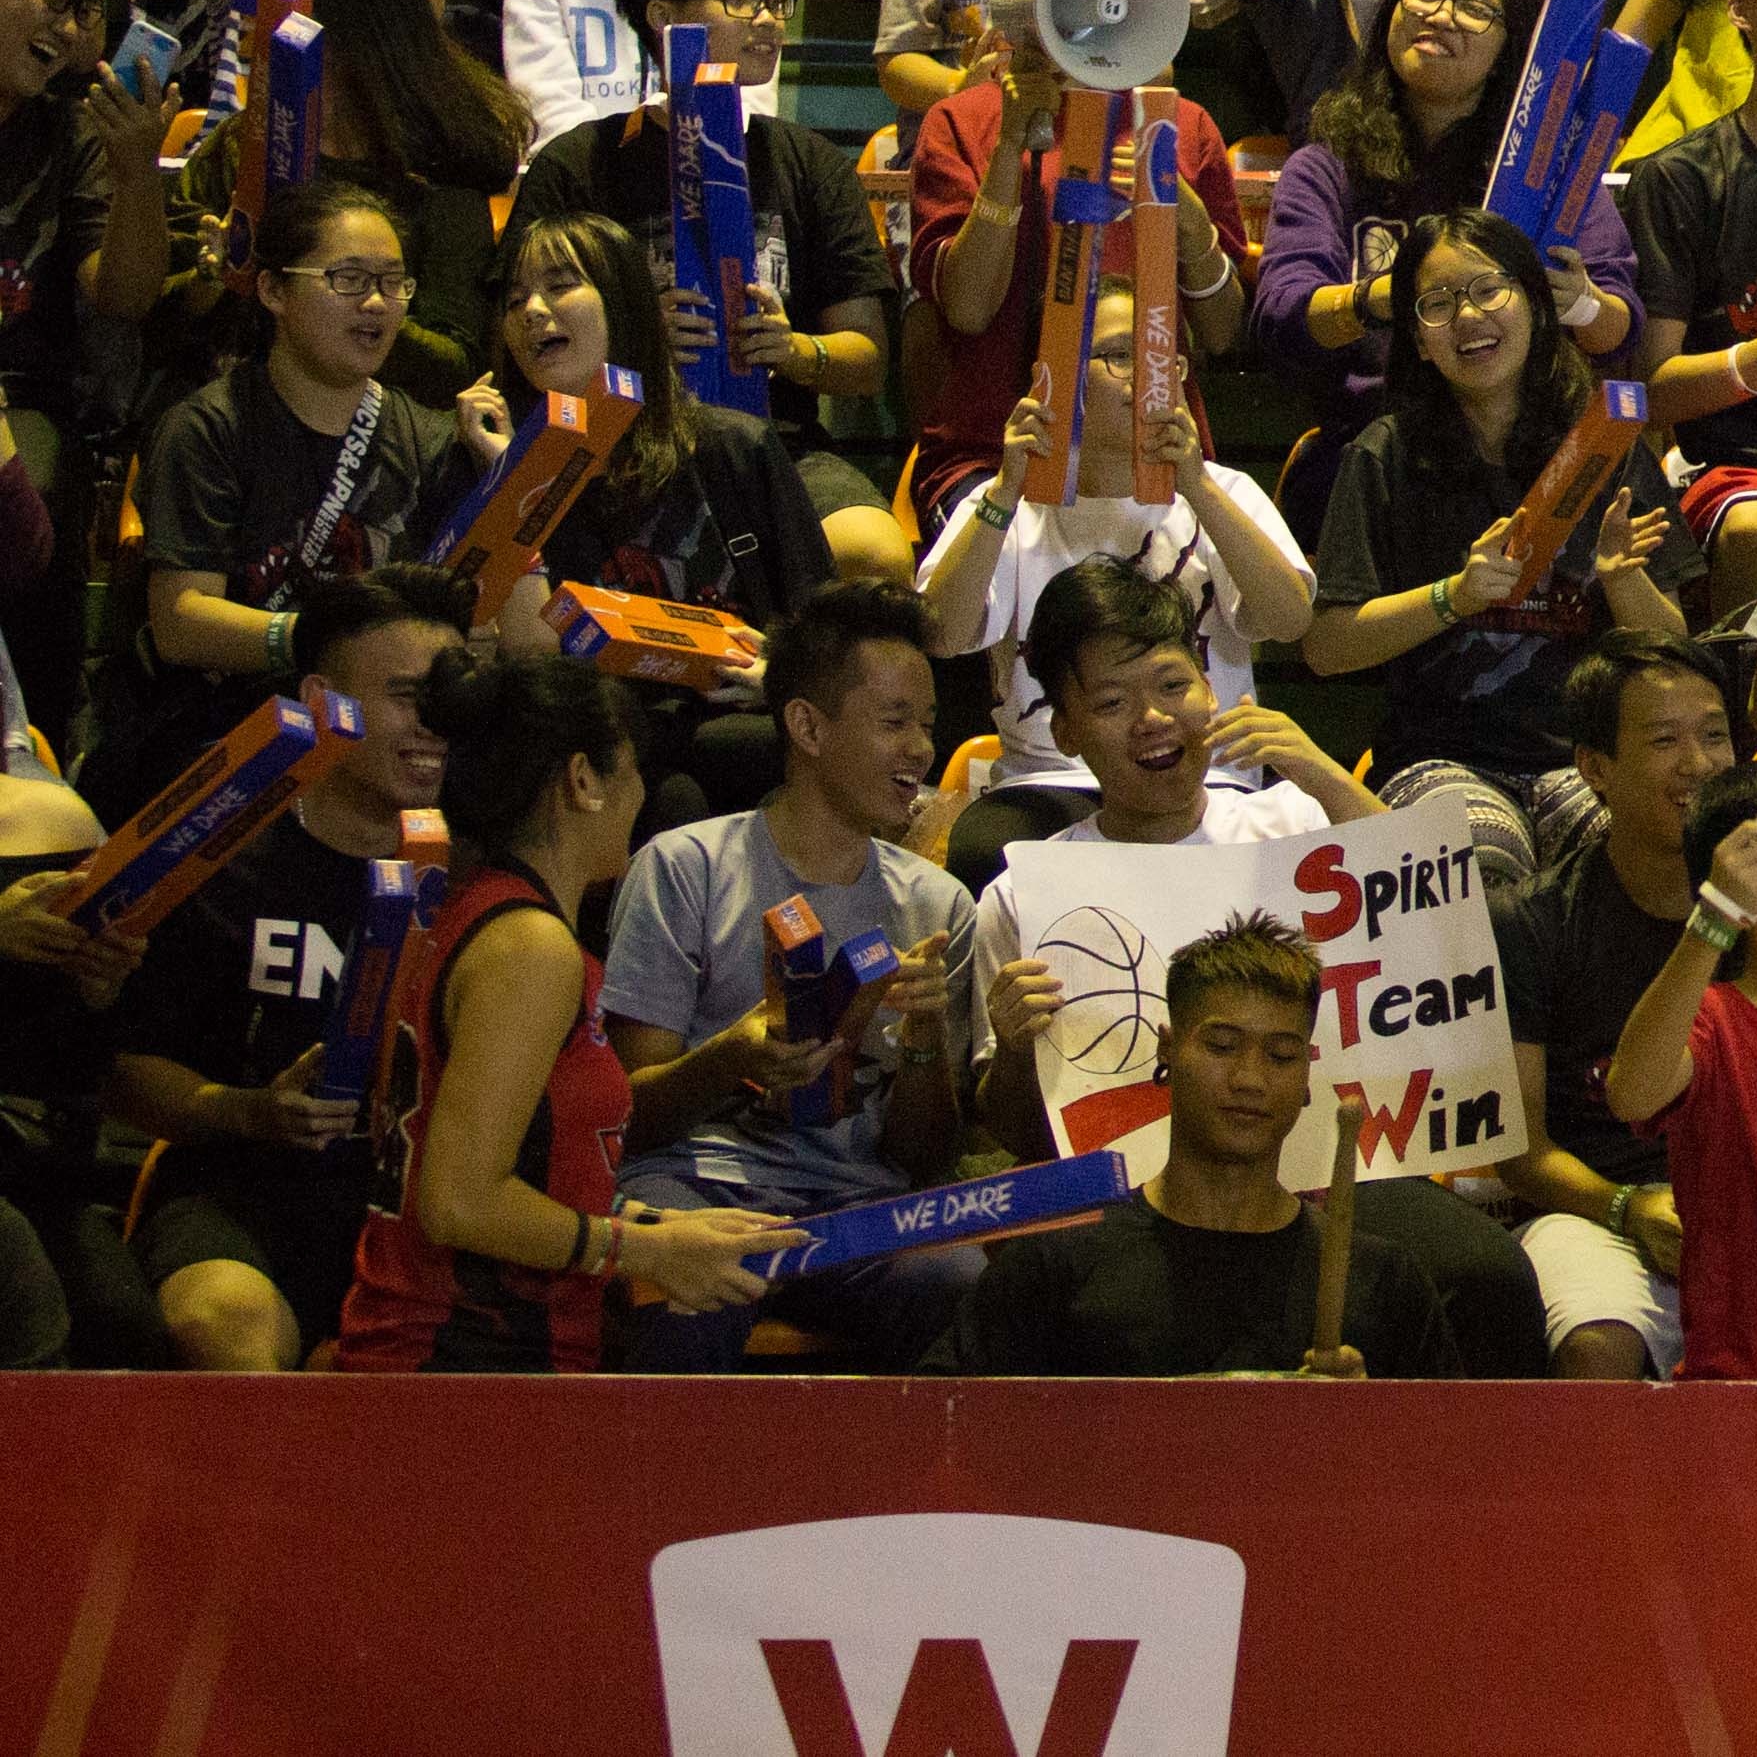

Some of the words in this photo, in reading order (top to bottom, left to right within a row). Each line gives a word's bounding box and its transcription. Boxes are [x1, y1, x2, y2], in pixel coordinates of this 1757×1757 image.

[1501, 131, 1525, 169] WE
[1513, 63, 1545, 131] DARE
[1147, 304, 1171, 348] WE
[162, 823, 200, 854] WE
[192, 784, 248, 829] DARE
[1333, 1069, 1505, 1170] Win
[892, 1198, 936, 1235] WE
[941, 1180, 1016, 1226] DARE
